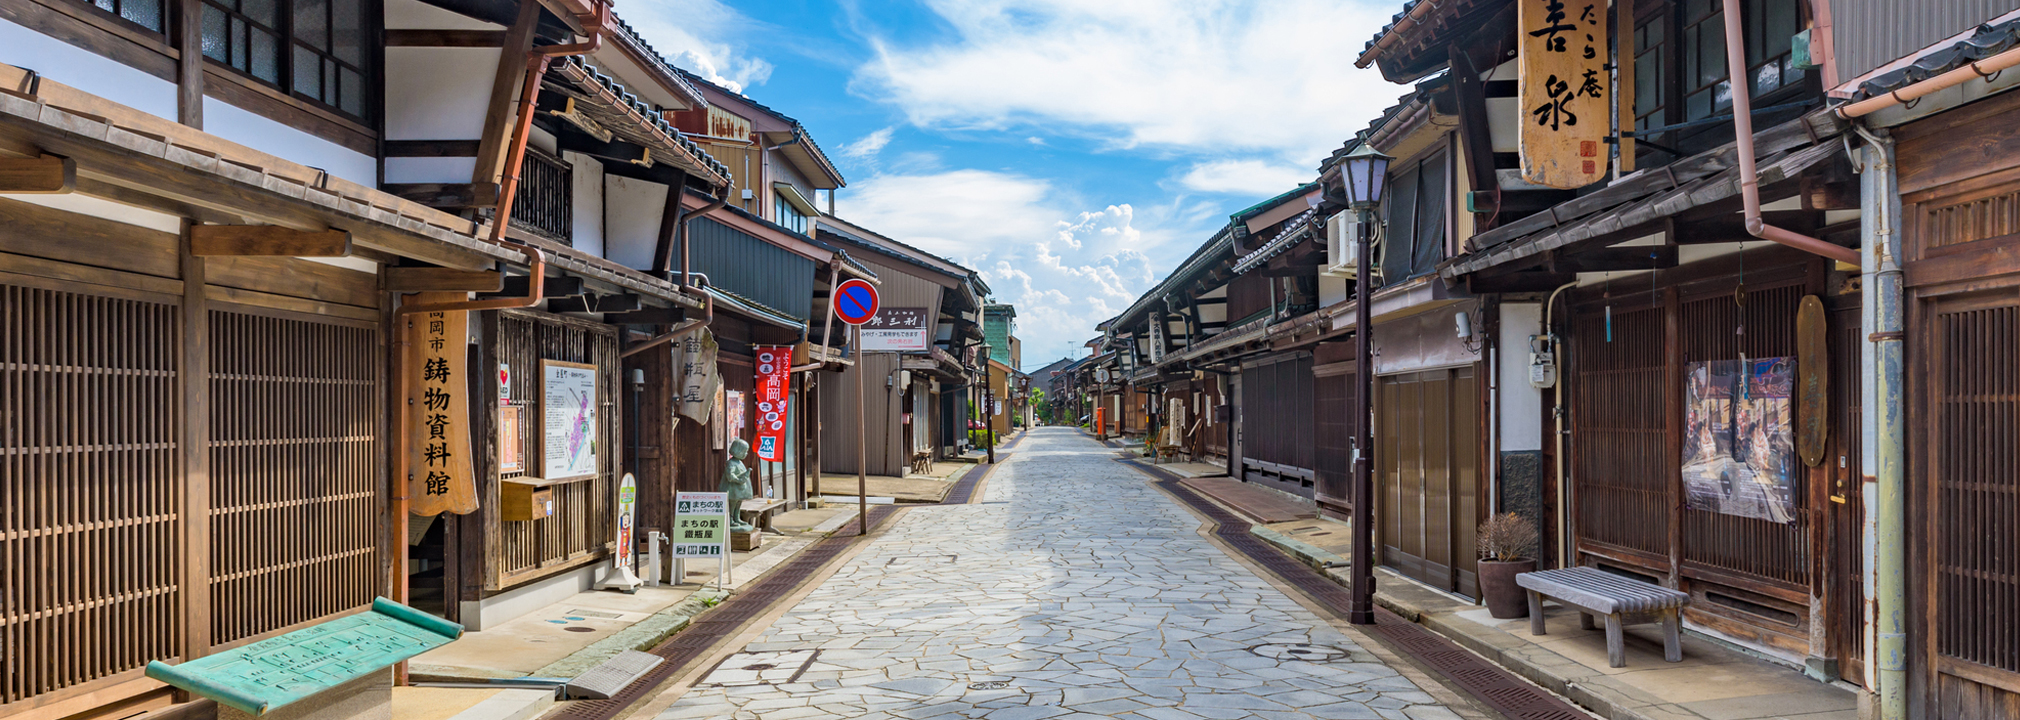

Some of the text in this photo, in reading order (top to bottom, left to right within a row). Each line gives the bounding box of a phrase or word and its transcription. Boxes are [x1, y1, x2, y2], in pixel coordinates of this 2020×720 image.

[782, 352, 790, 380] ようこそ
[766, 373, 781, 402] 高岡
[423, 356, 451, 497] 鋳物資料館
[692, 500, 724, 508] まちの駅
[681, 519, 719, 528] まちの駅
